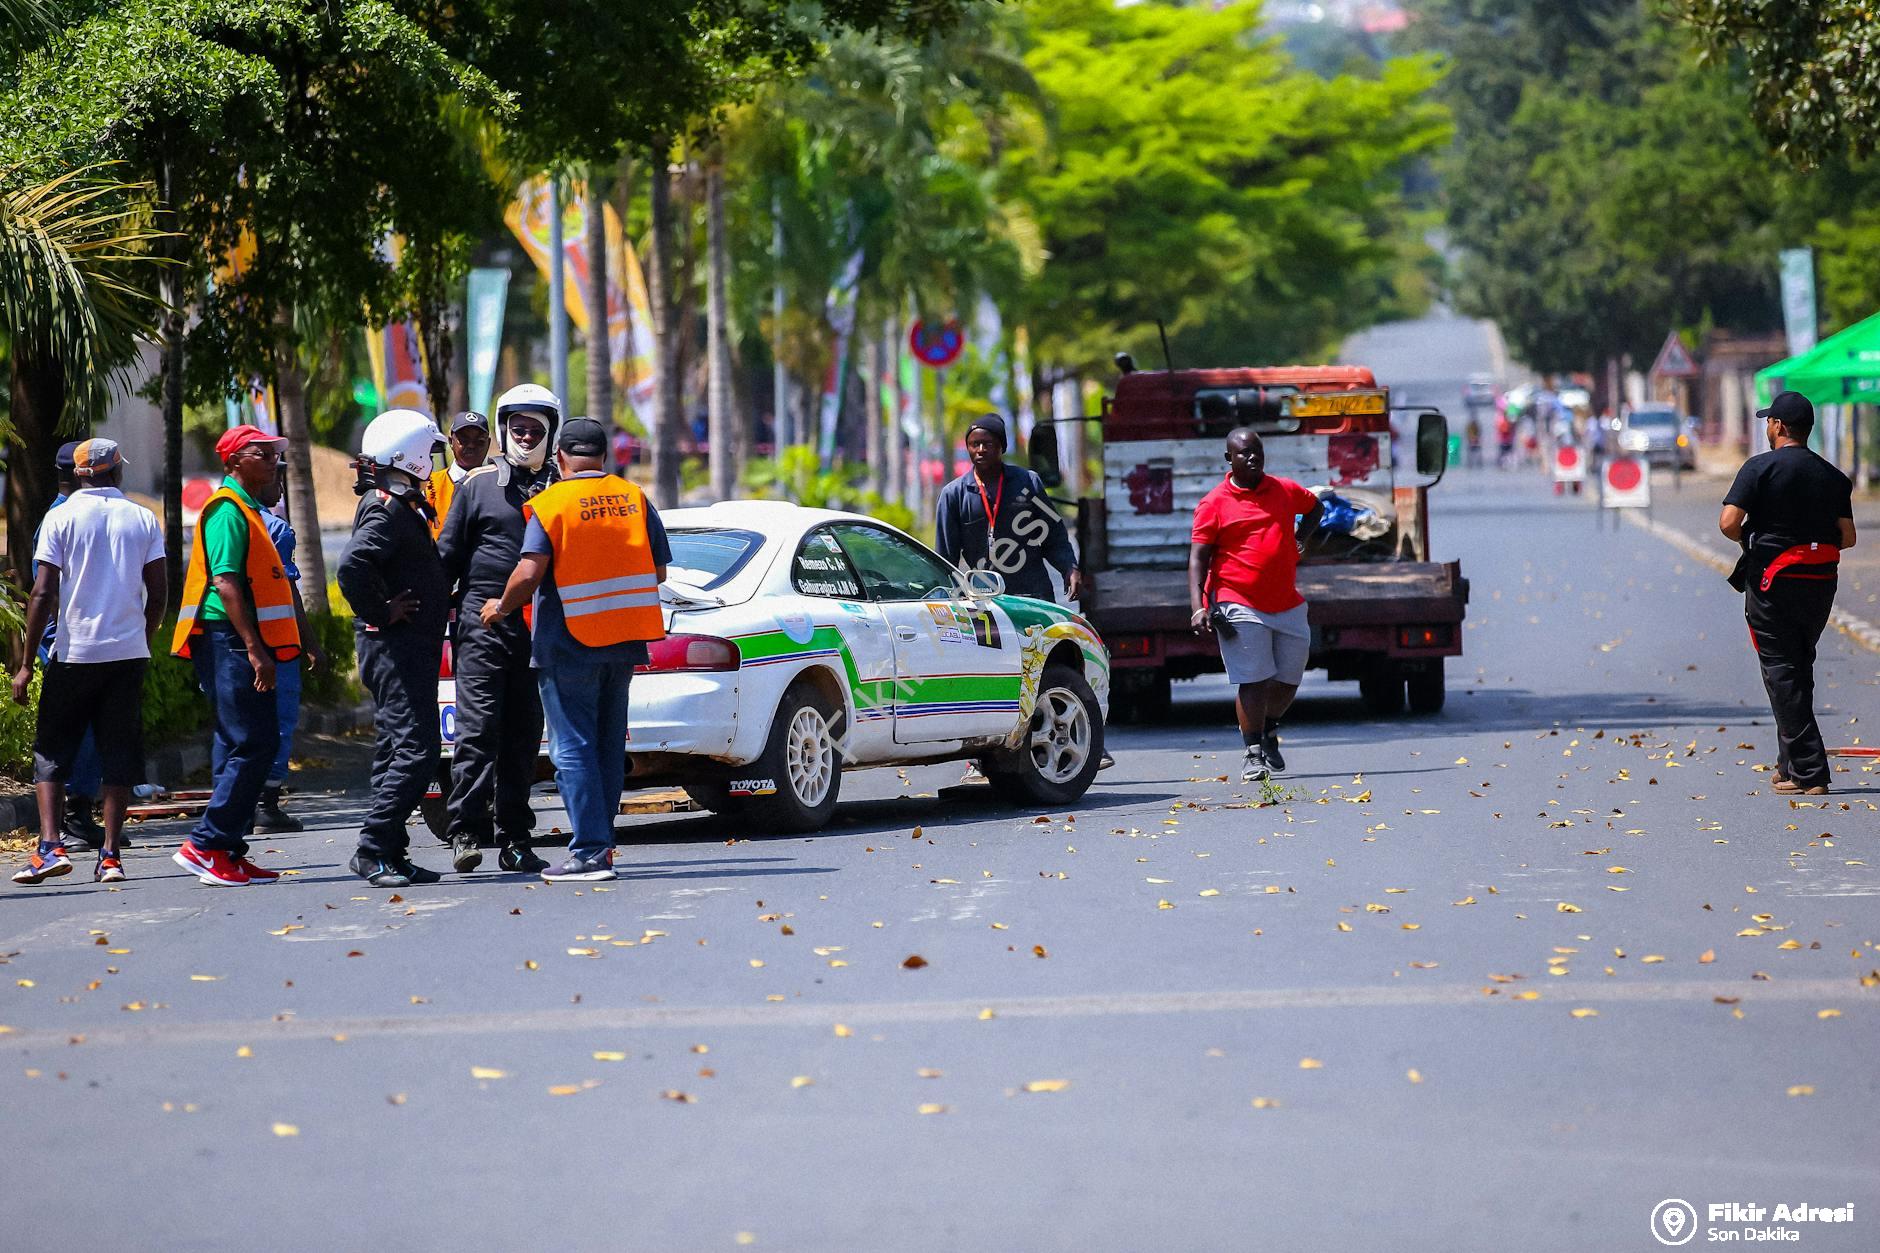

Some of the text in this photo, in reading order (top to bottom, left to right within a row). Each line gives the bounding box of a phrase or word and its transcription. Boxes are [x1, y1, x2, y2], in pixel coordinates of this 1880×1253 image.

[579, 493, 630, 508] SAFETY
[580, 504, 639, 521] OFFICER
[729, 778, 776, 790] TOYOTA
